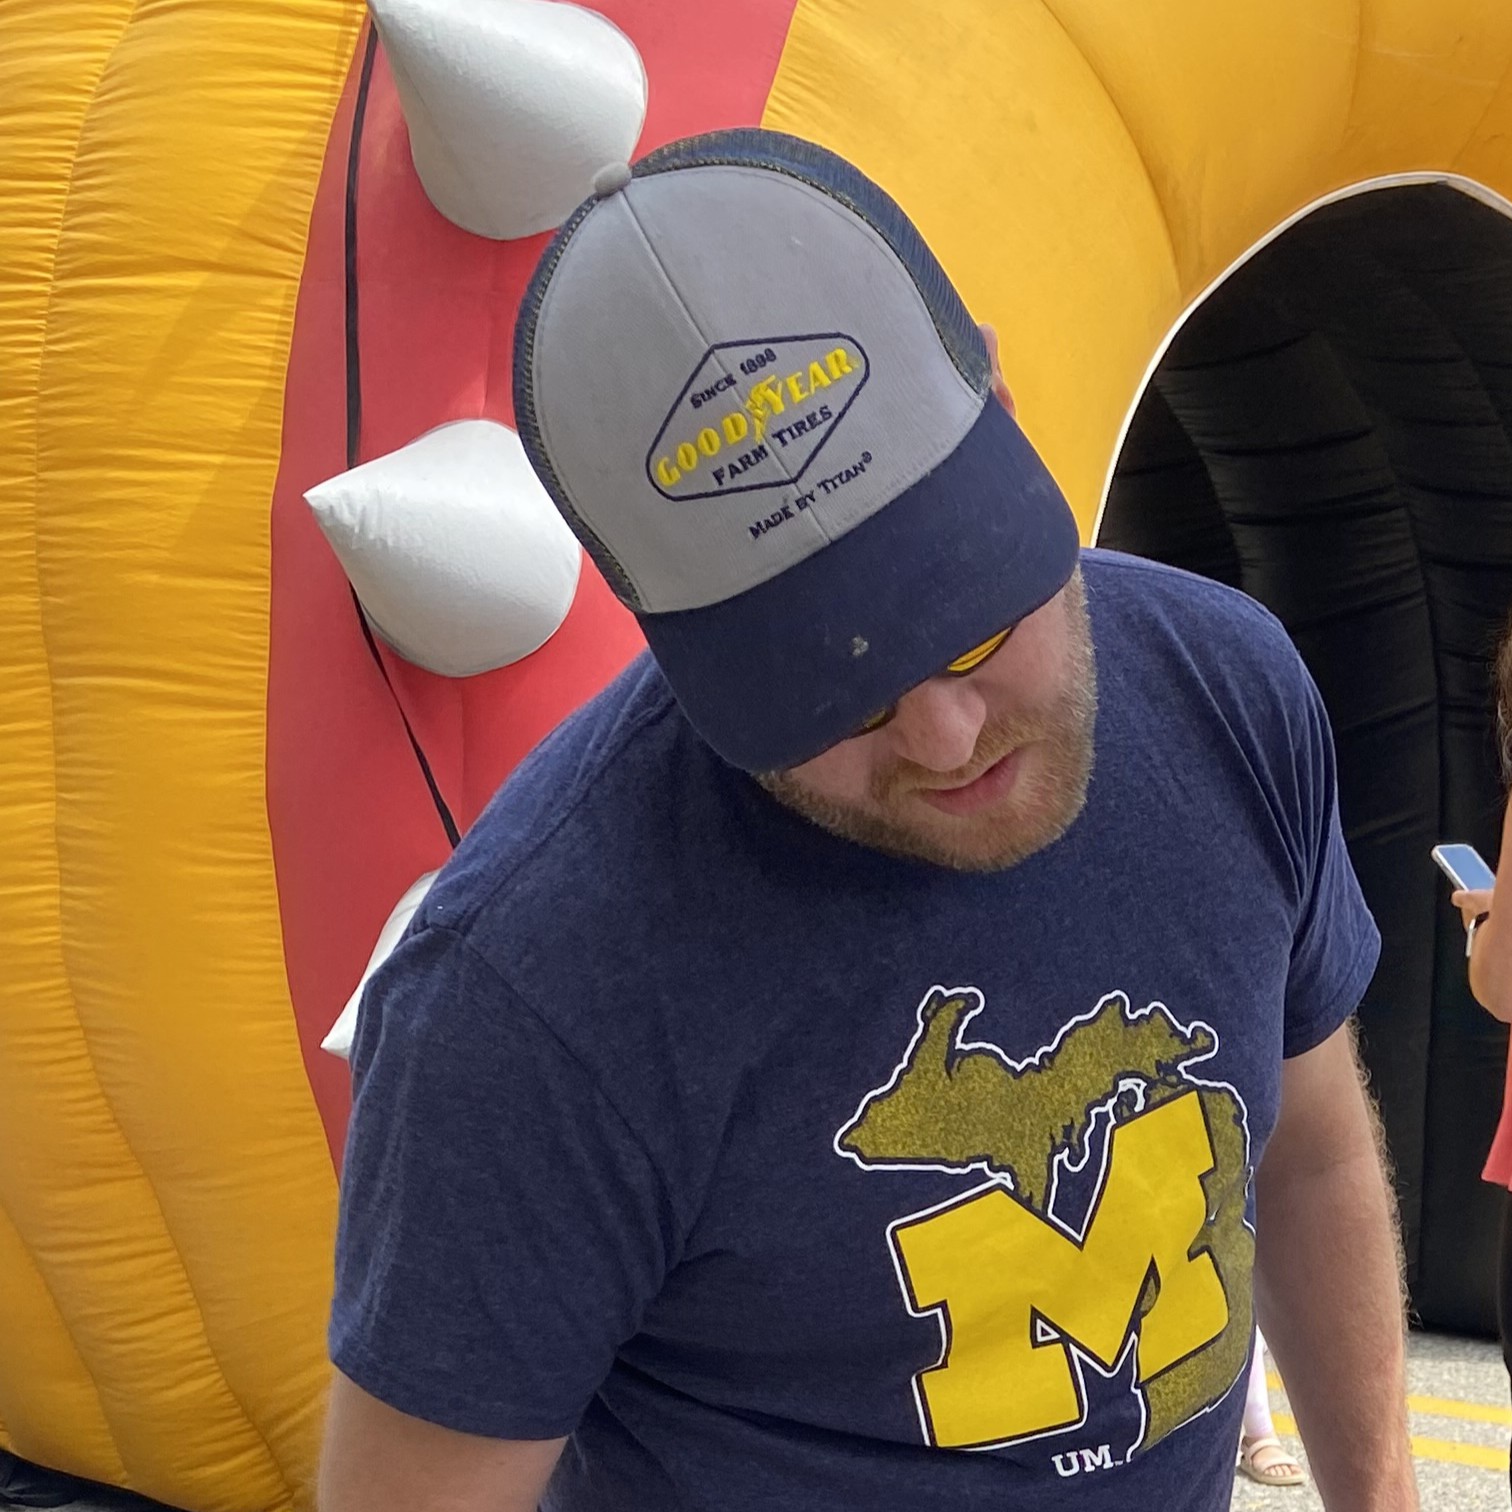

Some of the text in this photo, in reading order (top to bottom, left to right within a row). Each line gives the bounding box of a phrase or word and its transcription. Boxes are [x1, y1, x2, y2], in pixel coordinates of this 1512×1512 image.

[740, 348, 777, 377] 1898
[657, 348, 860, 488] GOODYEAR
[712, 405, 833, 487] FARM TIRES
